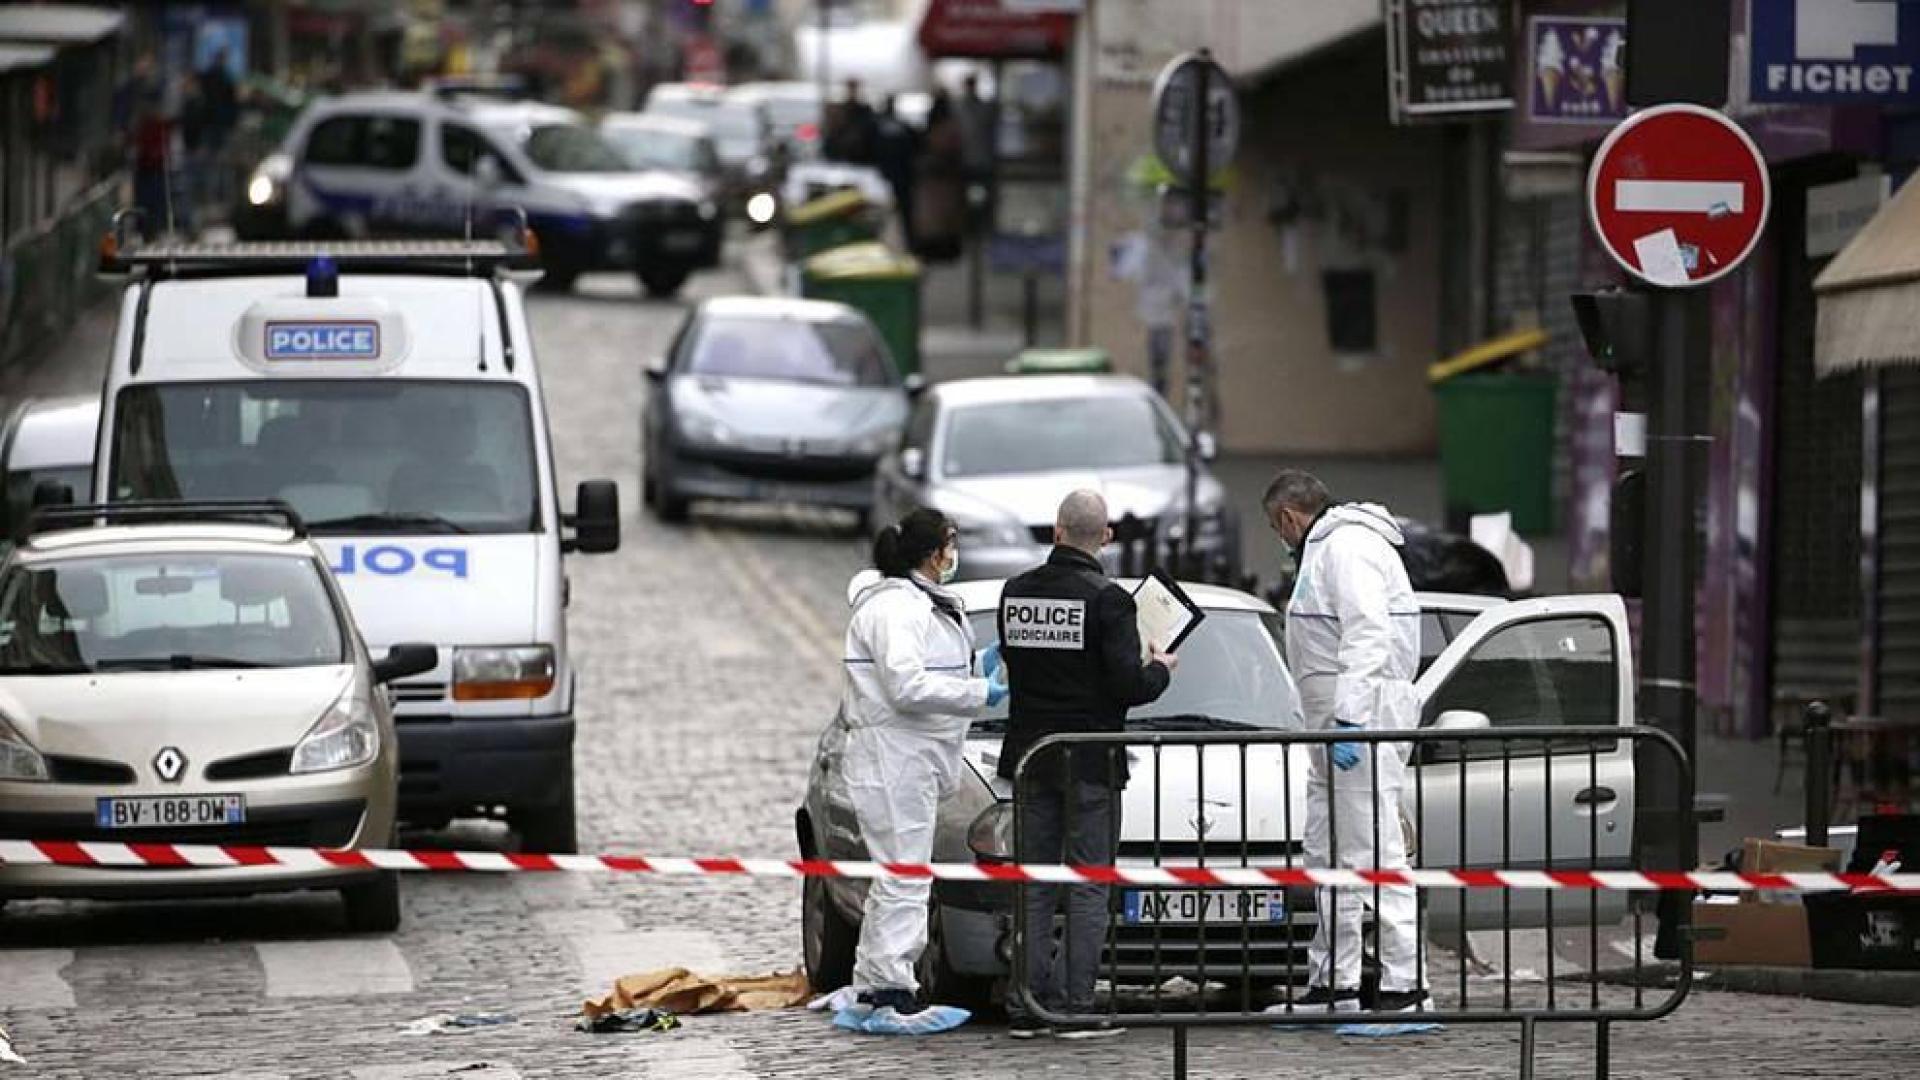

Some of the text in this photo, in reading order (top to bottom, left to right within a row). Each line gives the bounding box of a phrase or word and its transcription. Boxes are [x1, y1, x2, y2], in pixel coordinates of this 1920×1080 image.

[1418, 7, 1498, 38] QUEEN
[272, 330, 371, 351] POLICE
[1006, 605, 1082, 626] POLICE
[1008, 629, 1082, 643] JUDICIAIRE
